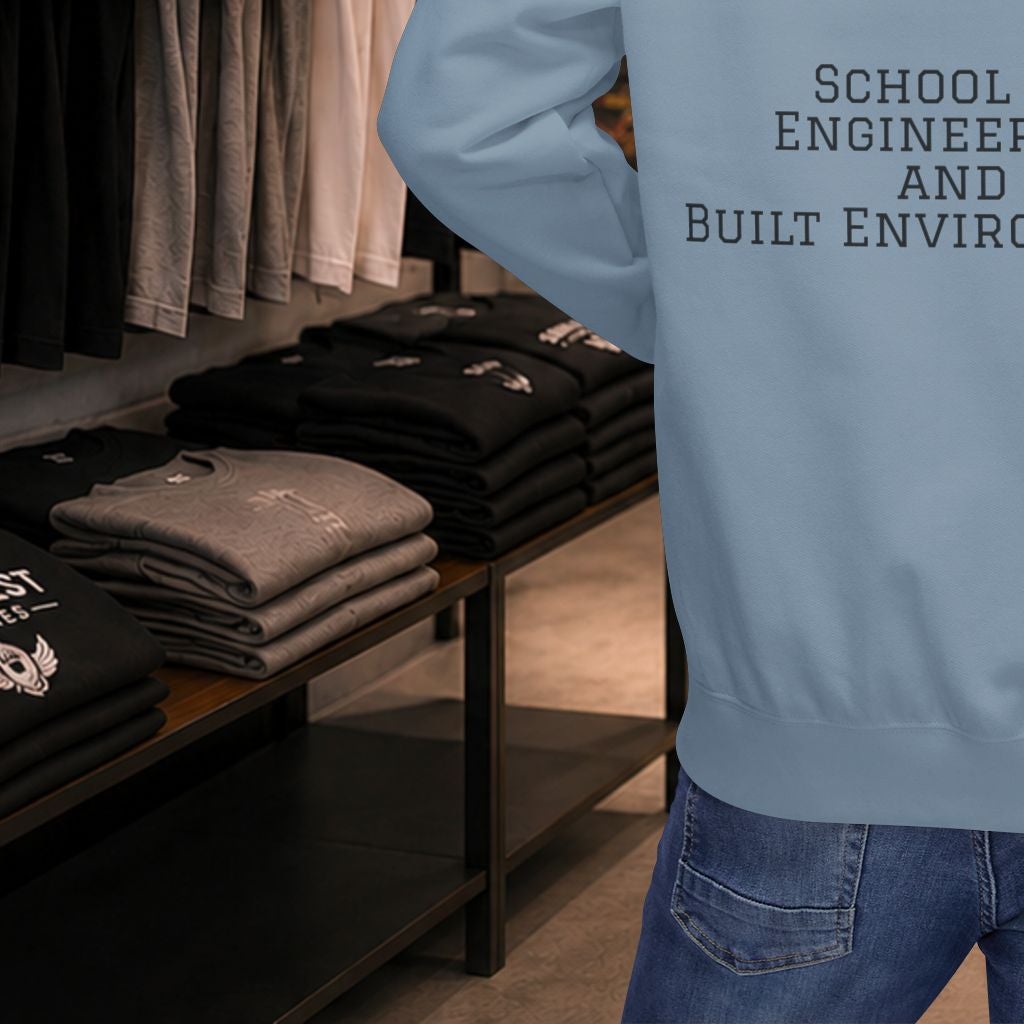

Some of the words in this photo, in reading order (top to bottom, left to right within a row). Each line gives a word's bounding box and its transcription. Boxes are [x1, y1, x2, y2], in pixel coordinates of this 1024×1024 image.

[814, 63, 1011, 105] SCHOOL
[897, 165, 1006, 201] AND
[685, 203, 821, 247] BUILT
